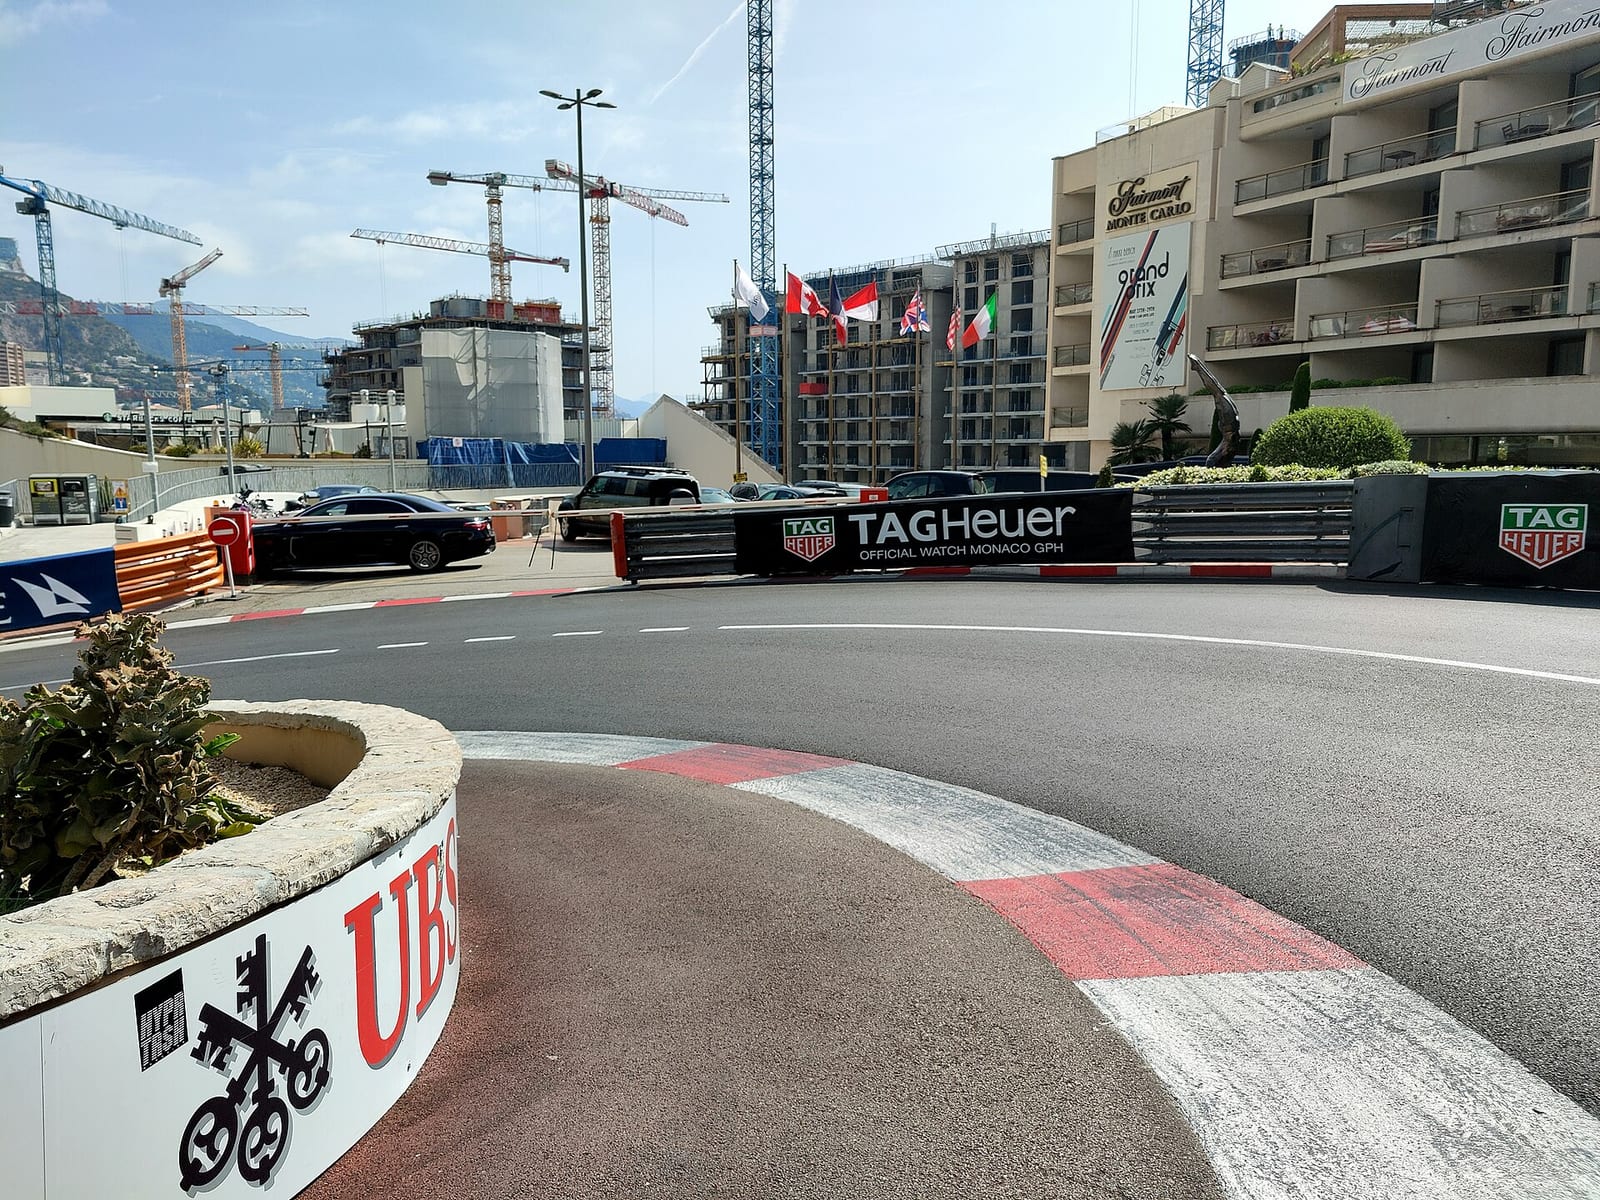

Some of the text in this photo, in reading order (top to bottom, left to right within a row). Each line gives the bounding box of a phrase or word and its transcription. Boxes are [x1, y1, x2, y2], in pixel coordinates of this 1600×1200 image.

[1485, 7, 1600, 61] Fairmon
[1350, 48, 1455, 99] Fairmont
[1108, 176, 1191, 217] Fairmont
[1106, 201, 1192, 231] MONTE CARLO
[1118, 251, 1169, 285] grand
[787, 520, 830, 535] TAG
[1508, 508, 1580, 529] TAG
[787, 537, 833, 558] HEUER
[859, 542, 1064, 560] OFFICIAL WATCH MONACO GPH
[1503, 532, 1580, 564] HEUER
[344, 816, 458, 1068] UBS
